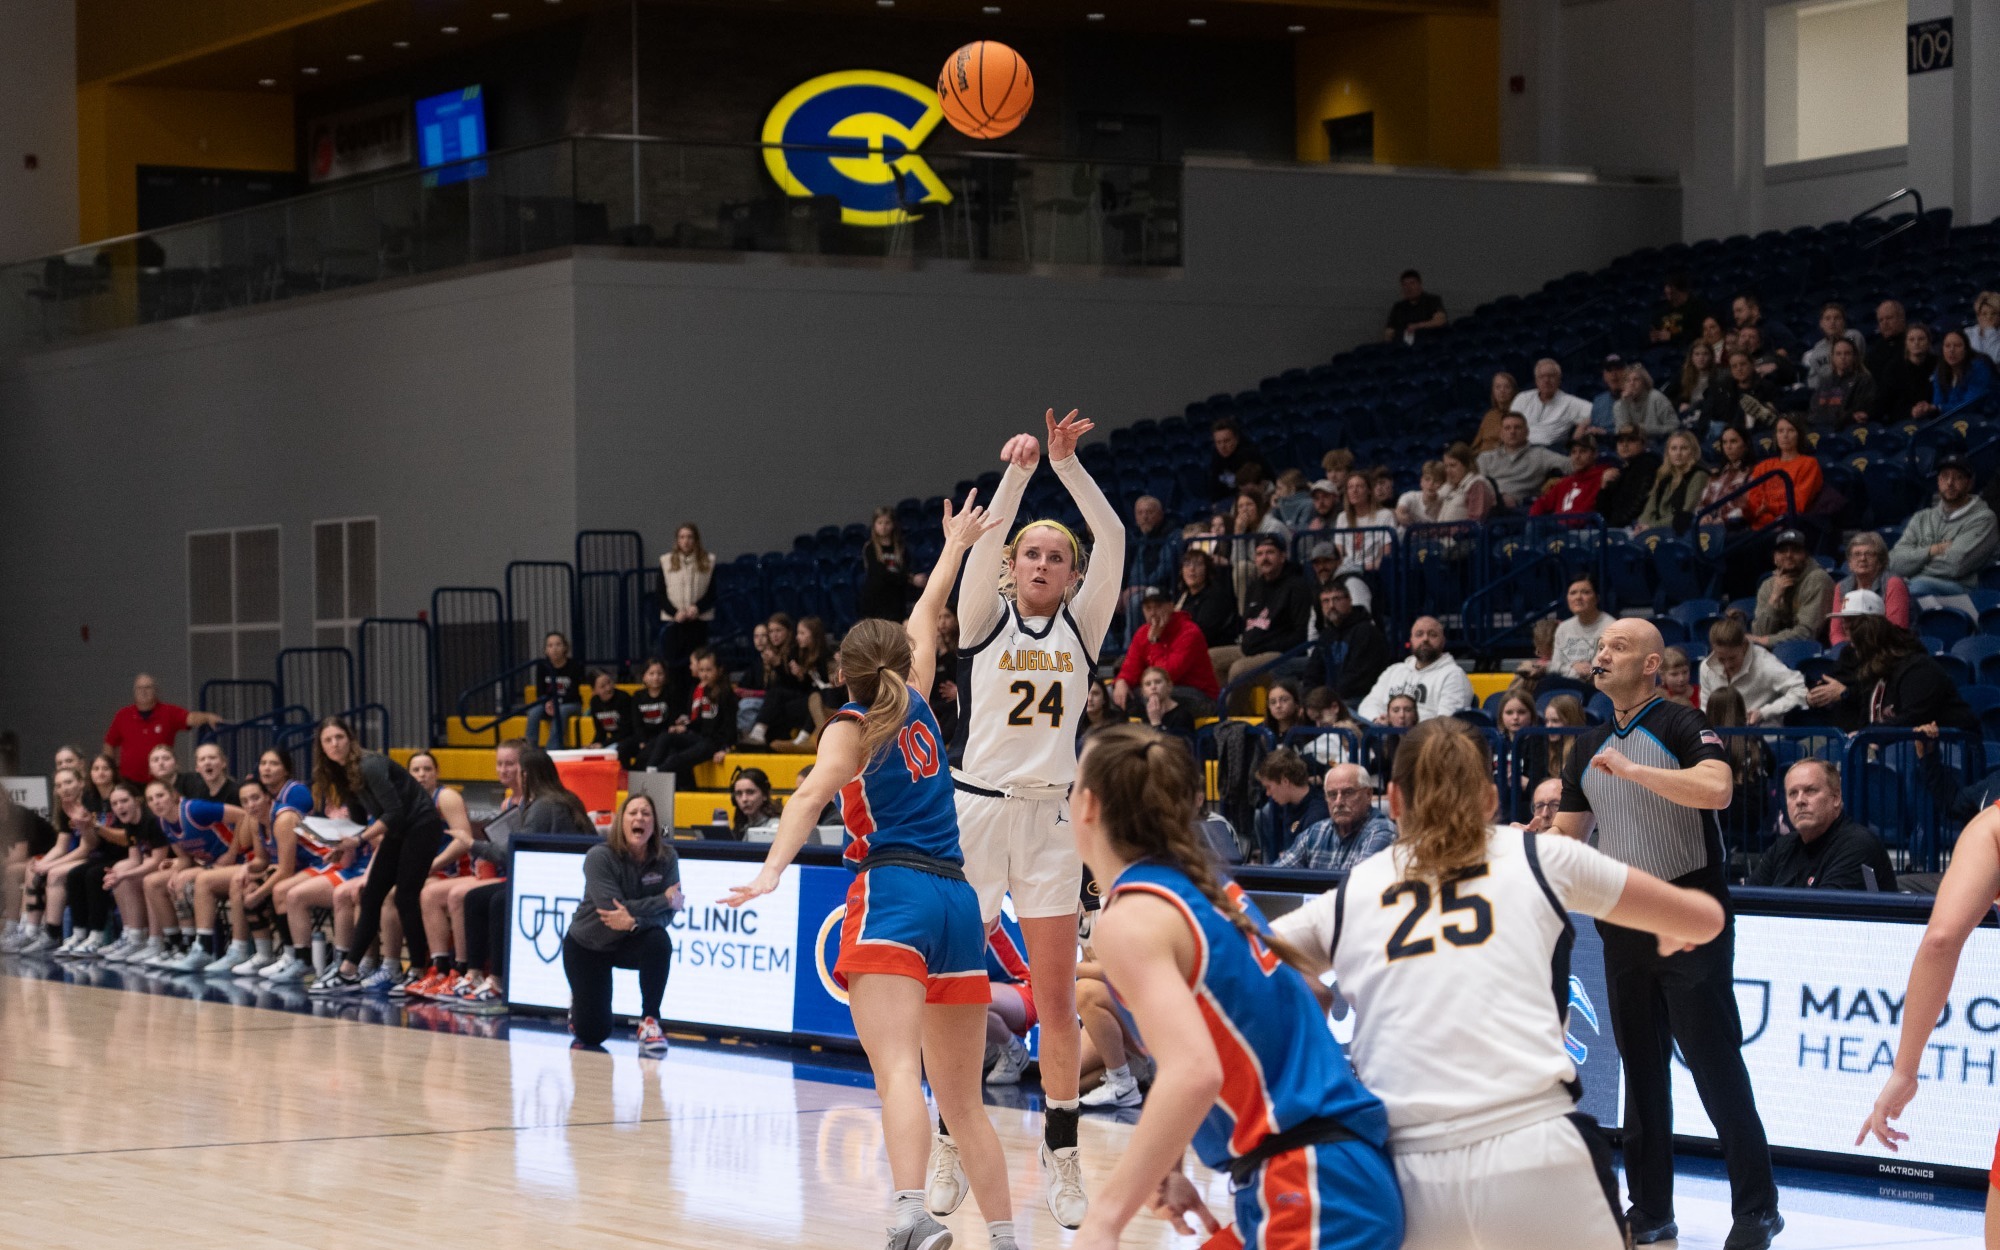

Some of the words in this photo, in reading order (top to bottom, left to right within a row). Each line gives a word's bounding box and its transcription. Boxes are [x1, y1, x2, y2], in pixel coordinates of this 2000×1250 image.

[1910, 31, 1951, 70] 109
[1007, 680, 1064, 728] 24
[898, 719, 940, 783] 10
[1381, 862, 1494, 963] 25
[690, 939, 790, 973] SYSTEM
[1801, 984, 1952, 1029] MAY
[1799, 1034, 1995, 1085] HEATH
[1879, 1164, 1934, 1178] DAKTRONICS
